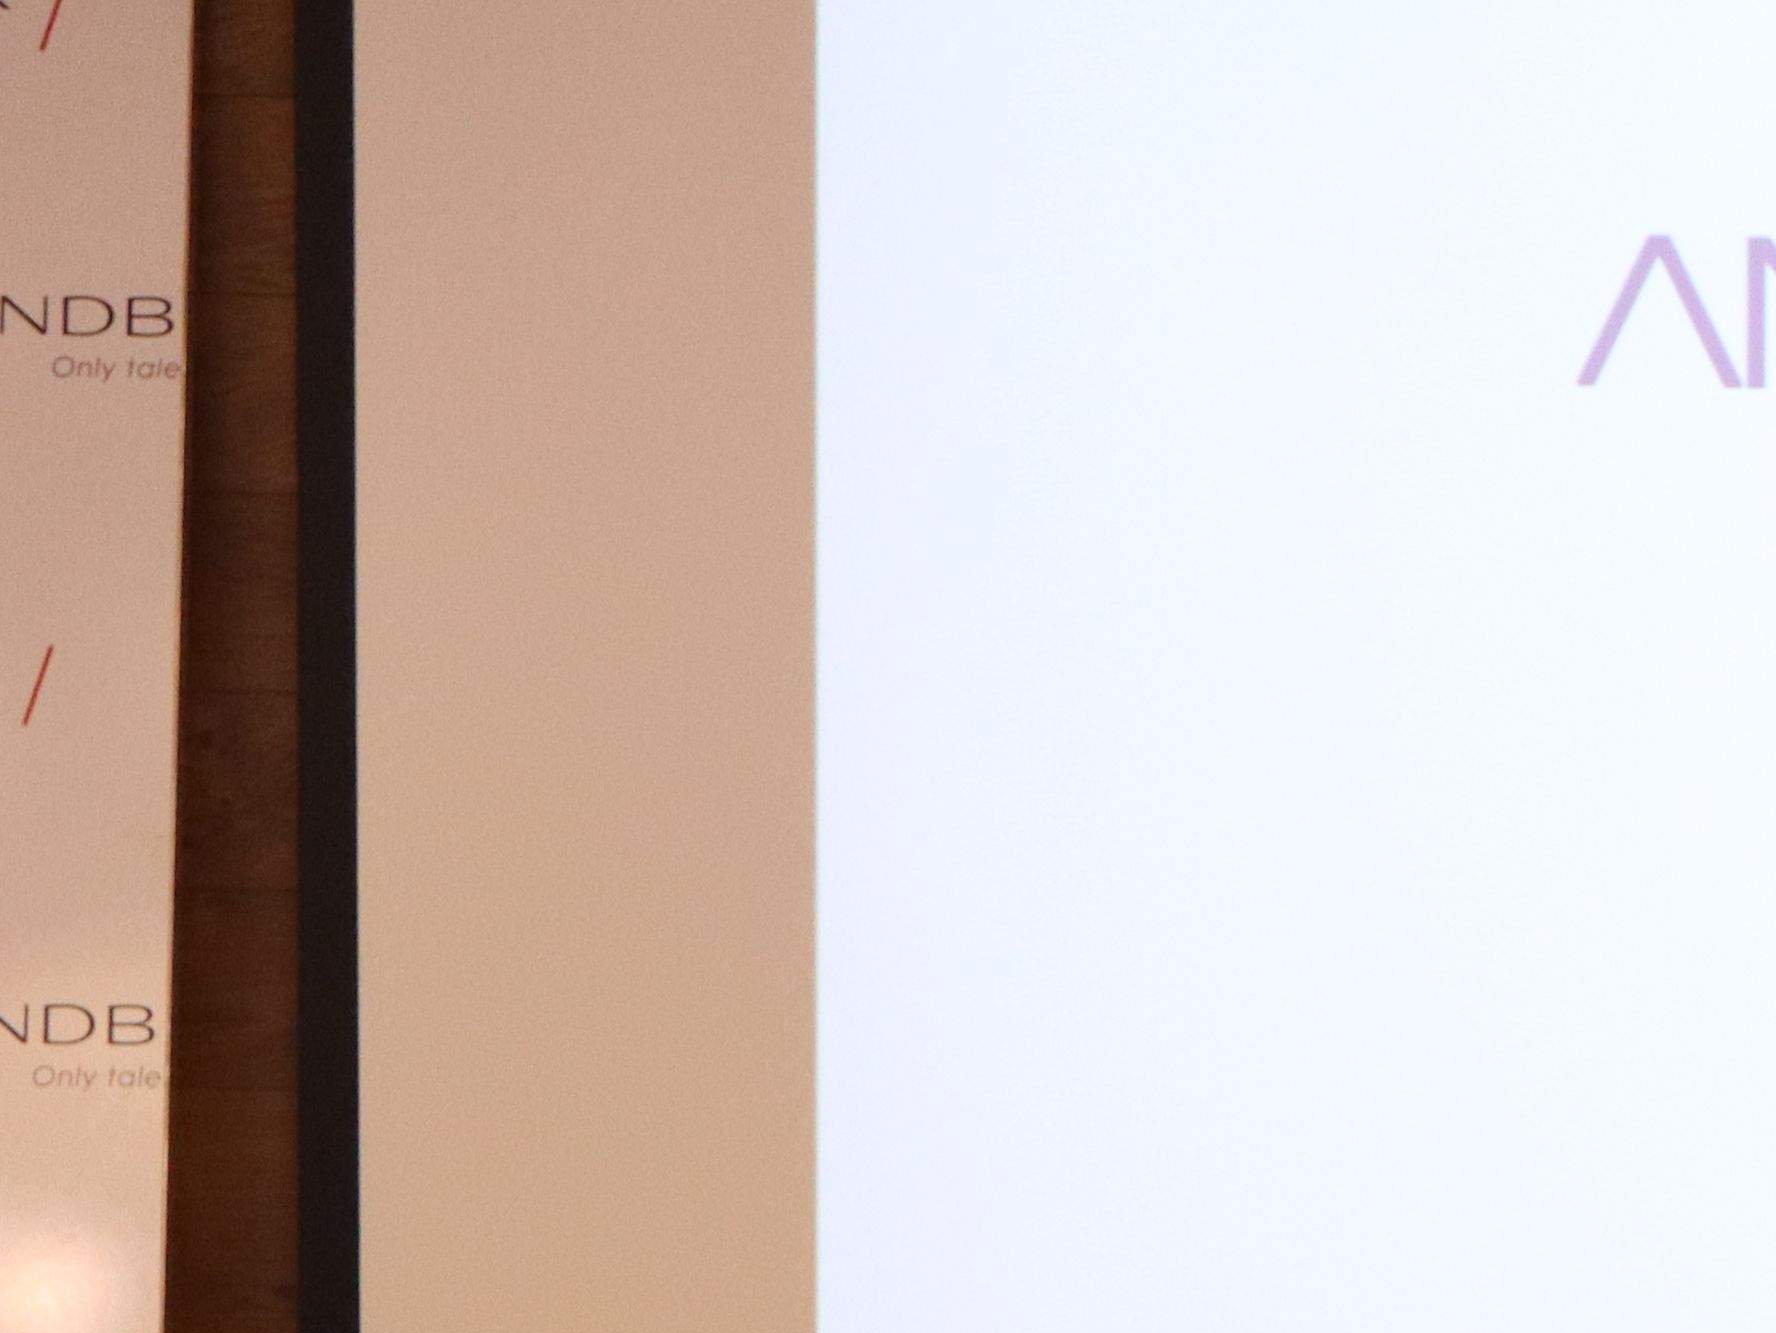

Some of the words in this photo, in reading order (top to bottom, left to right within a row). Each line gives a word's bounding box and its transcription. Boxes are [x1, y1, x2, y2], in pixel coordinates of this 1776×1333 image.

[0, 295, 174, 338] NDB
[52, 356, 117, 383] Only
[32, 1064, 99, 1093] Only
